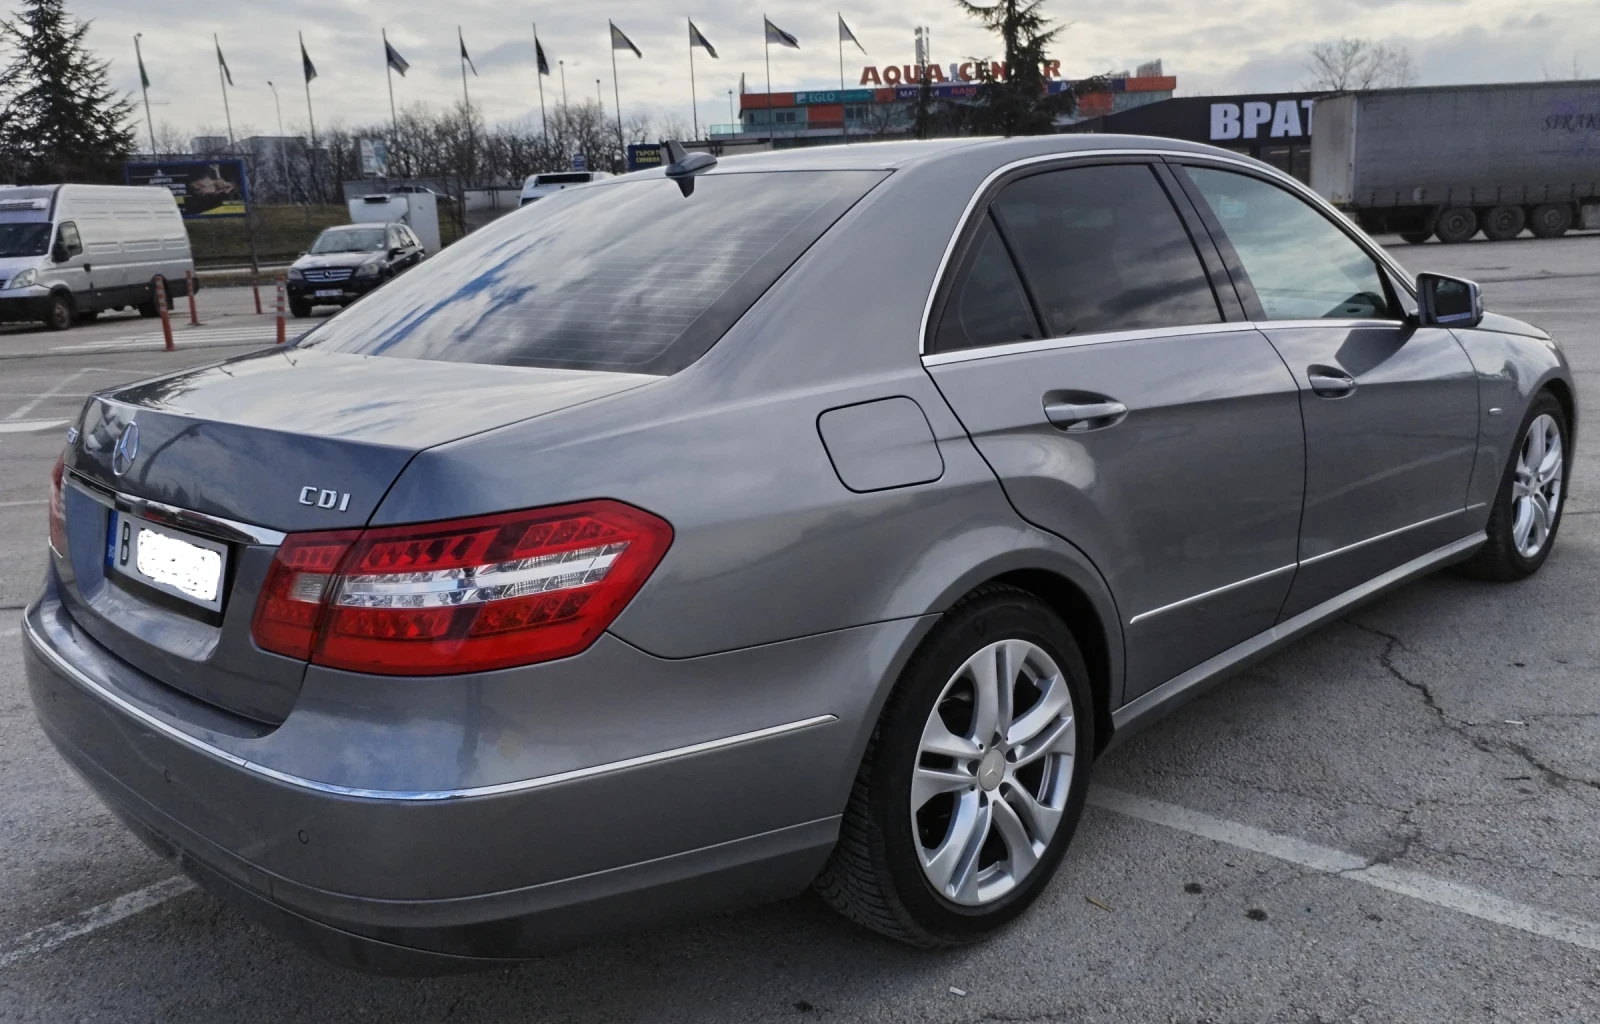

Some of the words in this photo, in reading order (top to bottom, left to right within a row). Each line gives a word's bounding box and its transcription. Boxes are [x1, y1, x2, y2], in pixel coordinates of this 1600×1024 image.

[859, 64, 944, 85] AQUA
[959, 59, 1061, 83] CENR
[809, 93, 835, 102] EGLO
[299, 486, 351, 512] CDI
[120, 520, 131, 567] B
